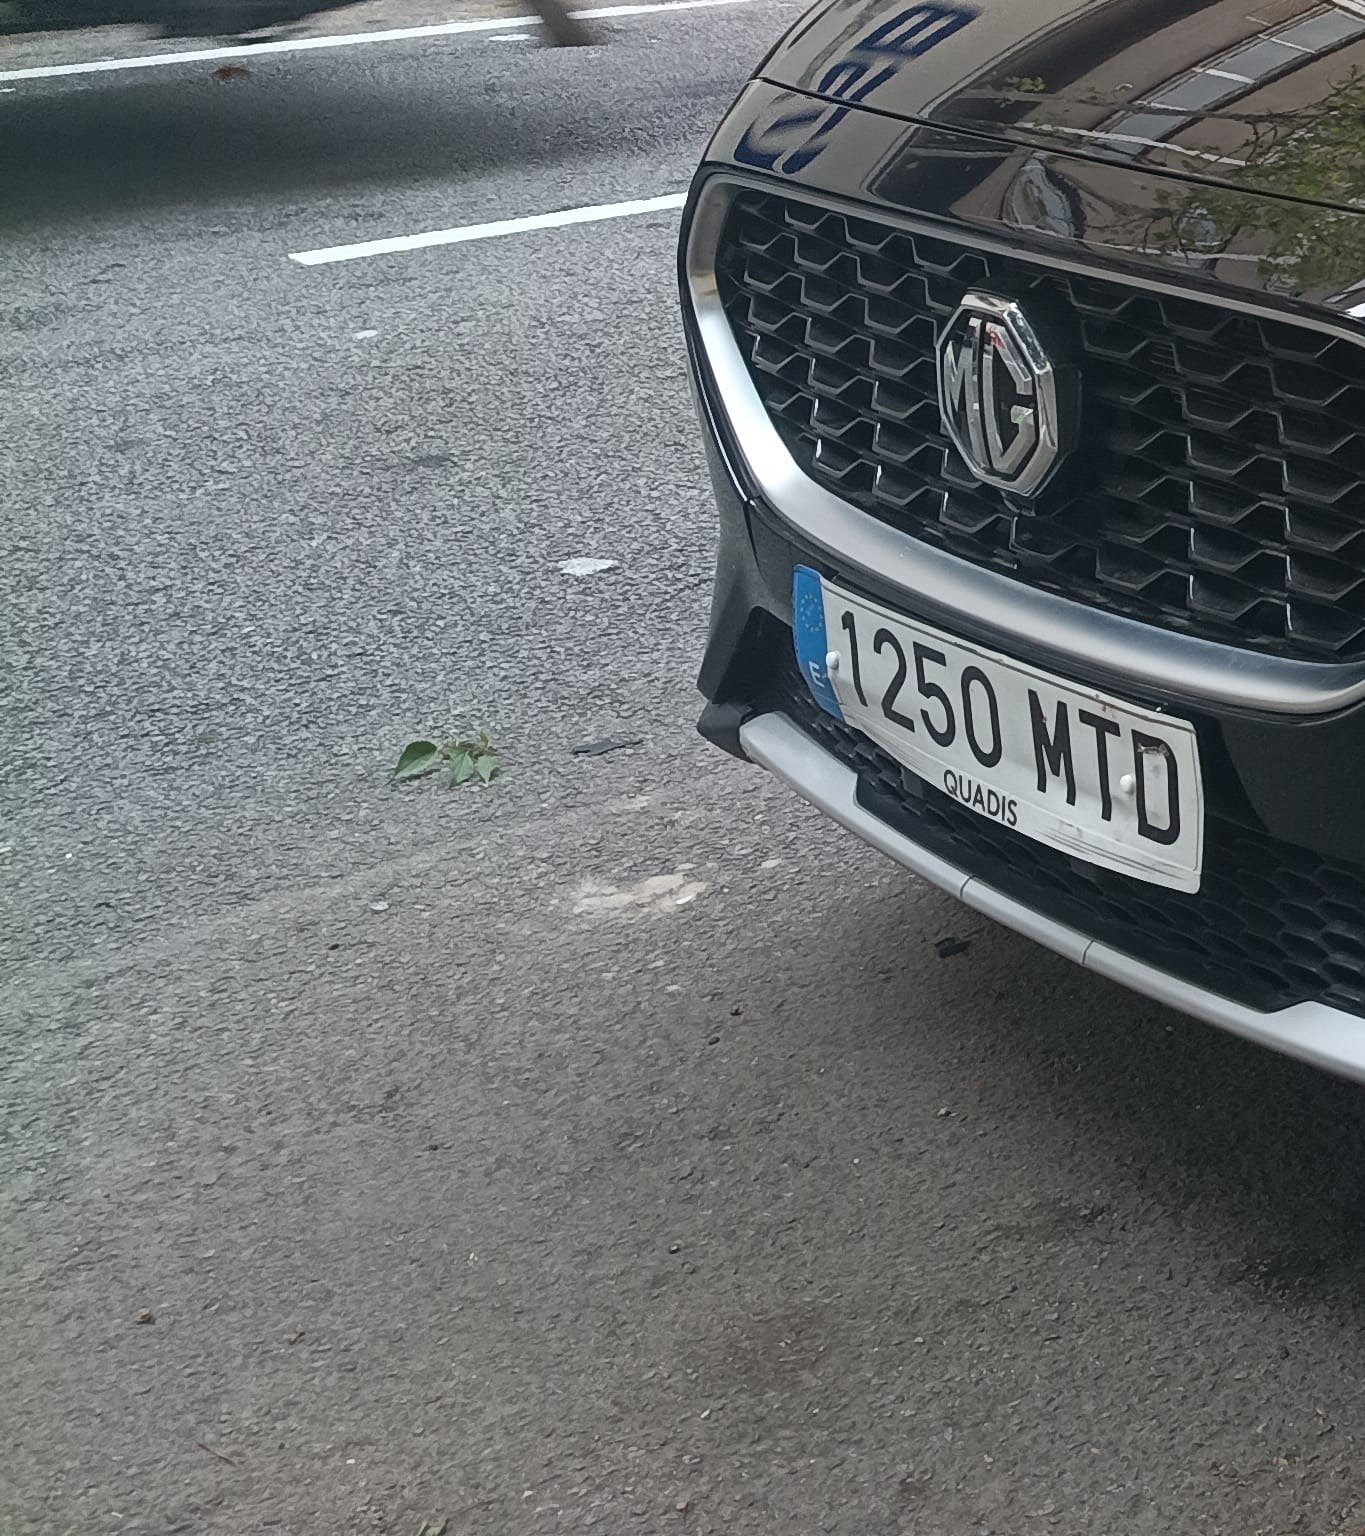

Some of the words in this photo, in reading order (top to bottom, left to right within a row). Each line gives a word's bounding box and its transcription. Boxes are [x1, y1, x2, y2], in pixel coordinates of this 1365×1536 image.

[942, 314, 1038, 476] MG
[841, 610, 1003, 769] 1250
[1027, 688, 1182, 846] MTD
[943, 768, 1019, 828] QUADIS
